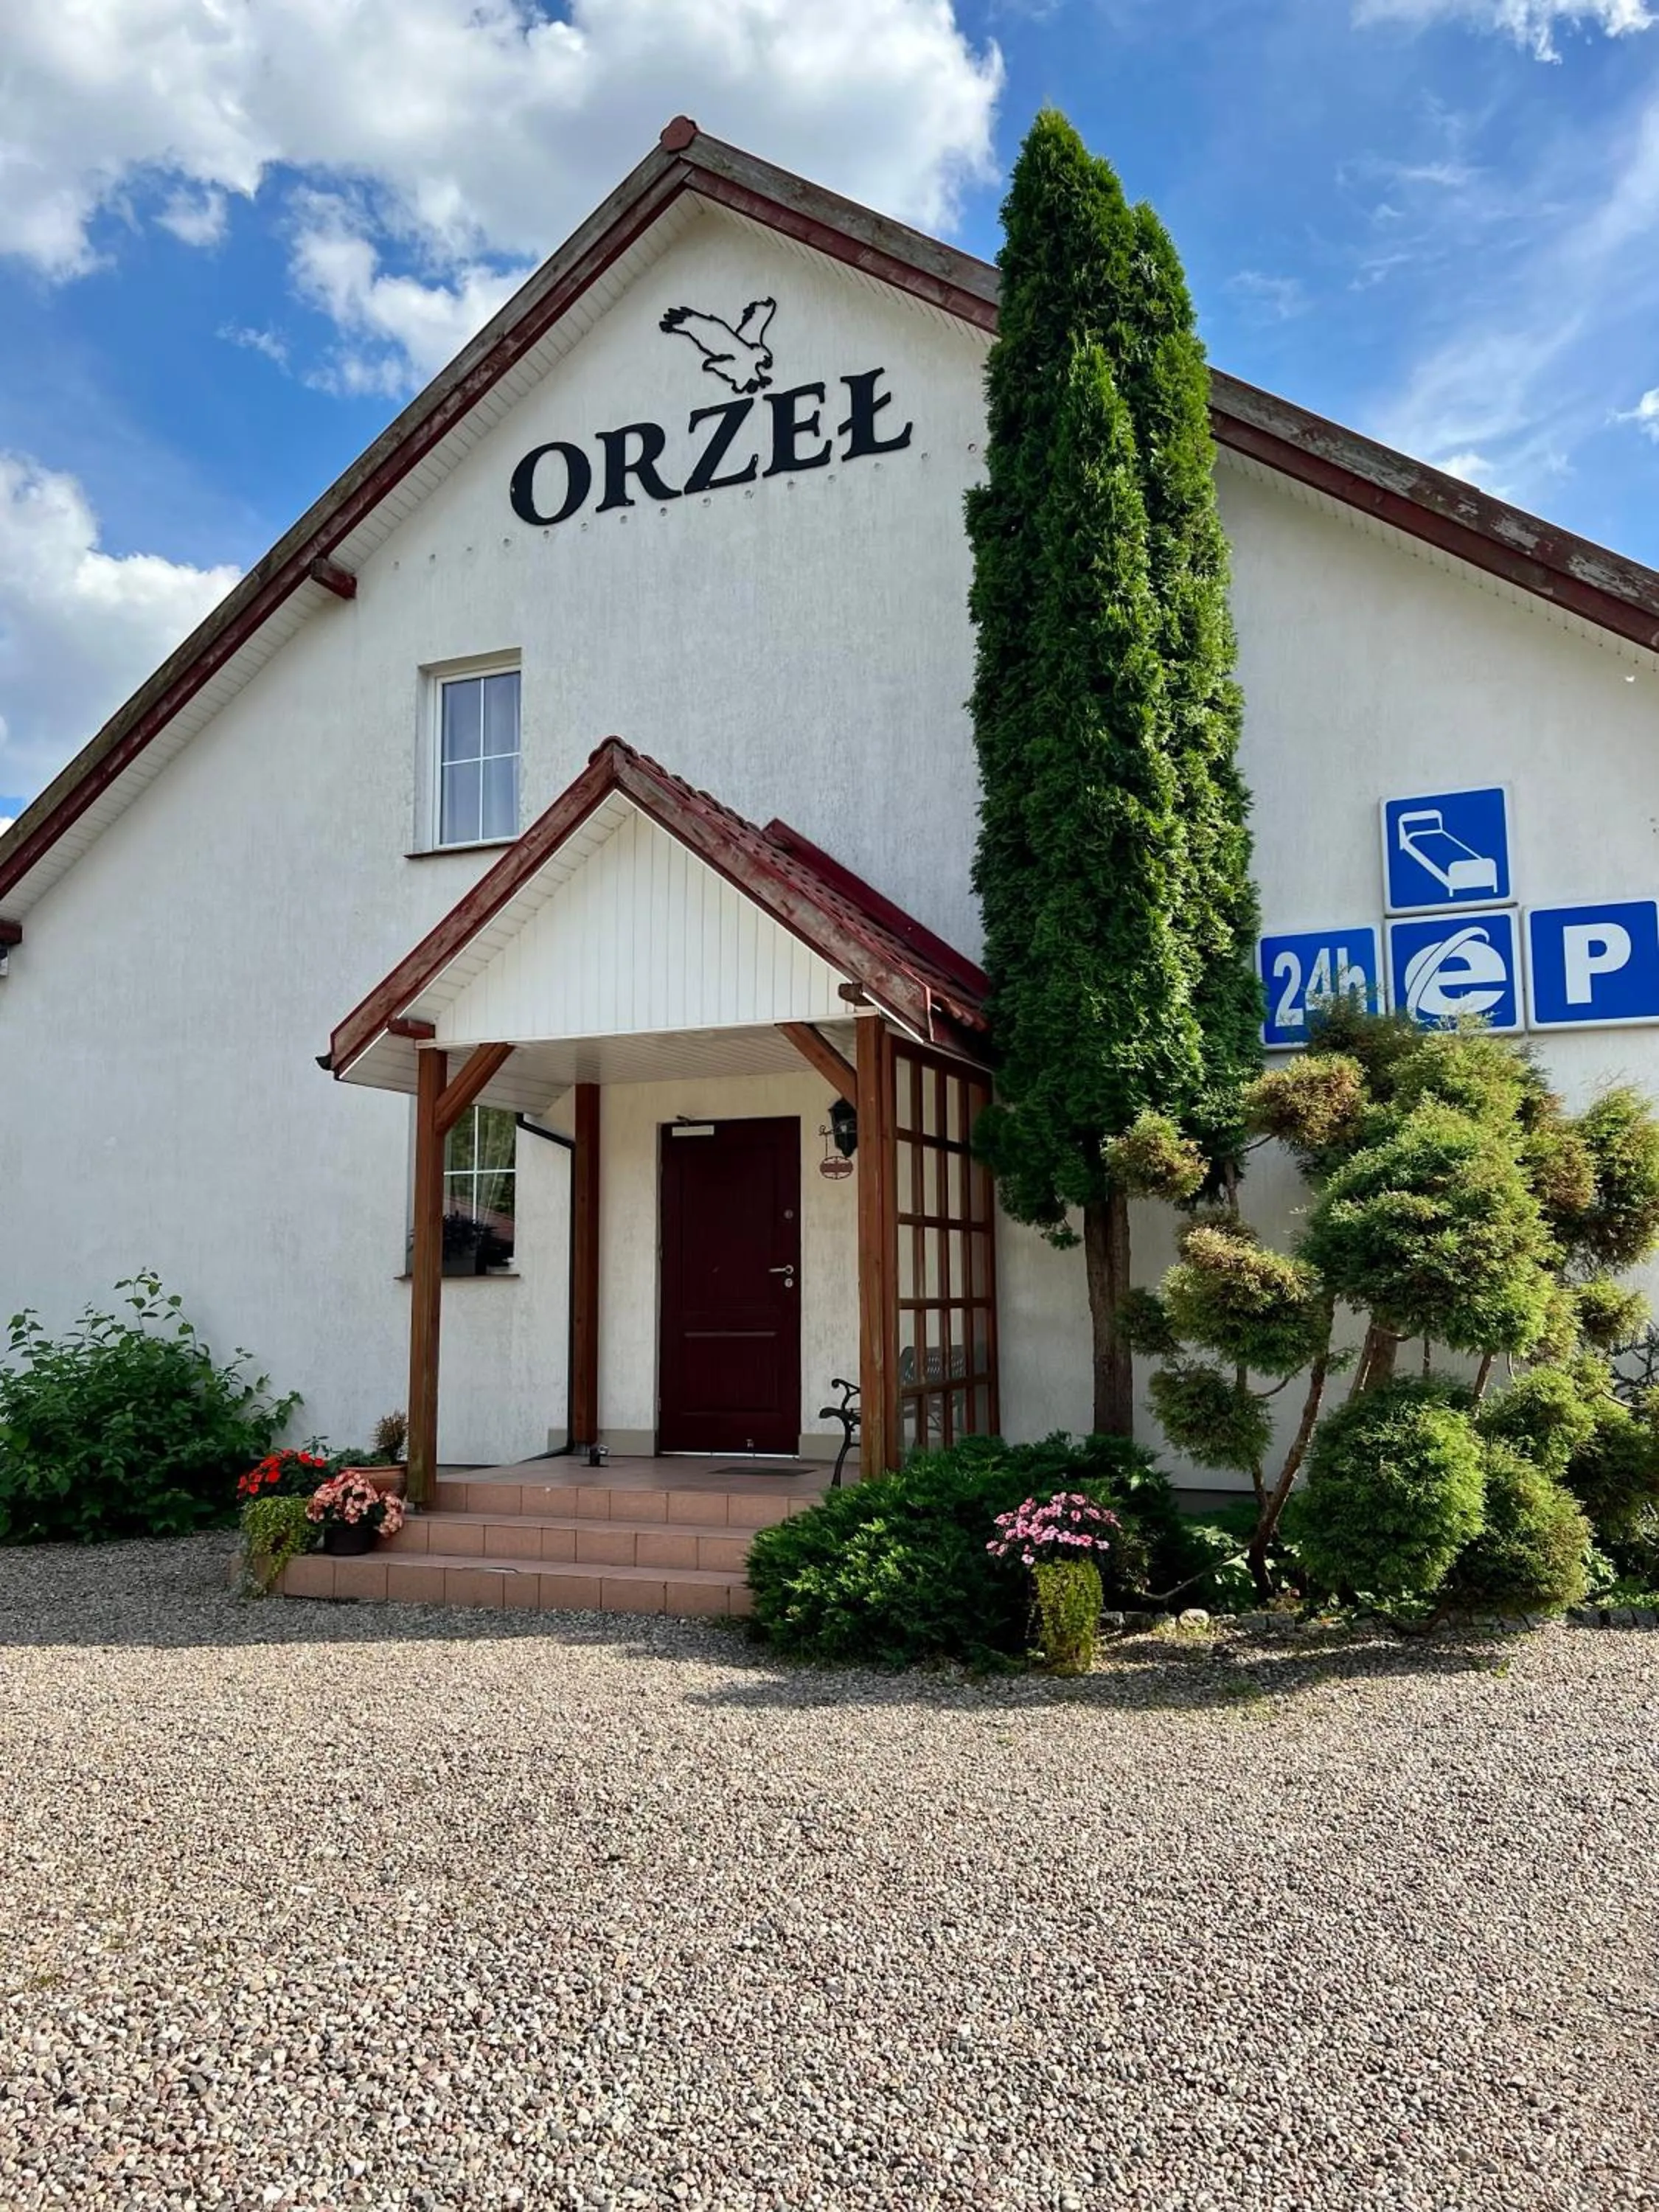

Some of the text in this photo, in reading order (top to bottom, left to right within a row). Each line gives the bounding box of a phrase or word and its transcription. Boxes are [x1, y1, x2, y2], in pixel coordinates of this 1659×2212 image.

[510, 367, 913, 526] ORZEŁ
[1273, 947, 1368, 1027] 24h
[1562, 922, 1632, 1004] P
